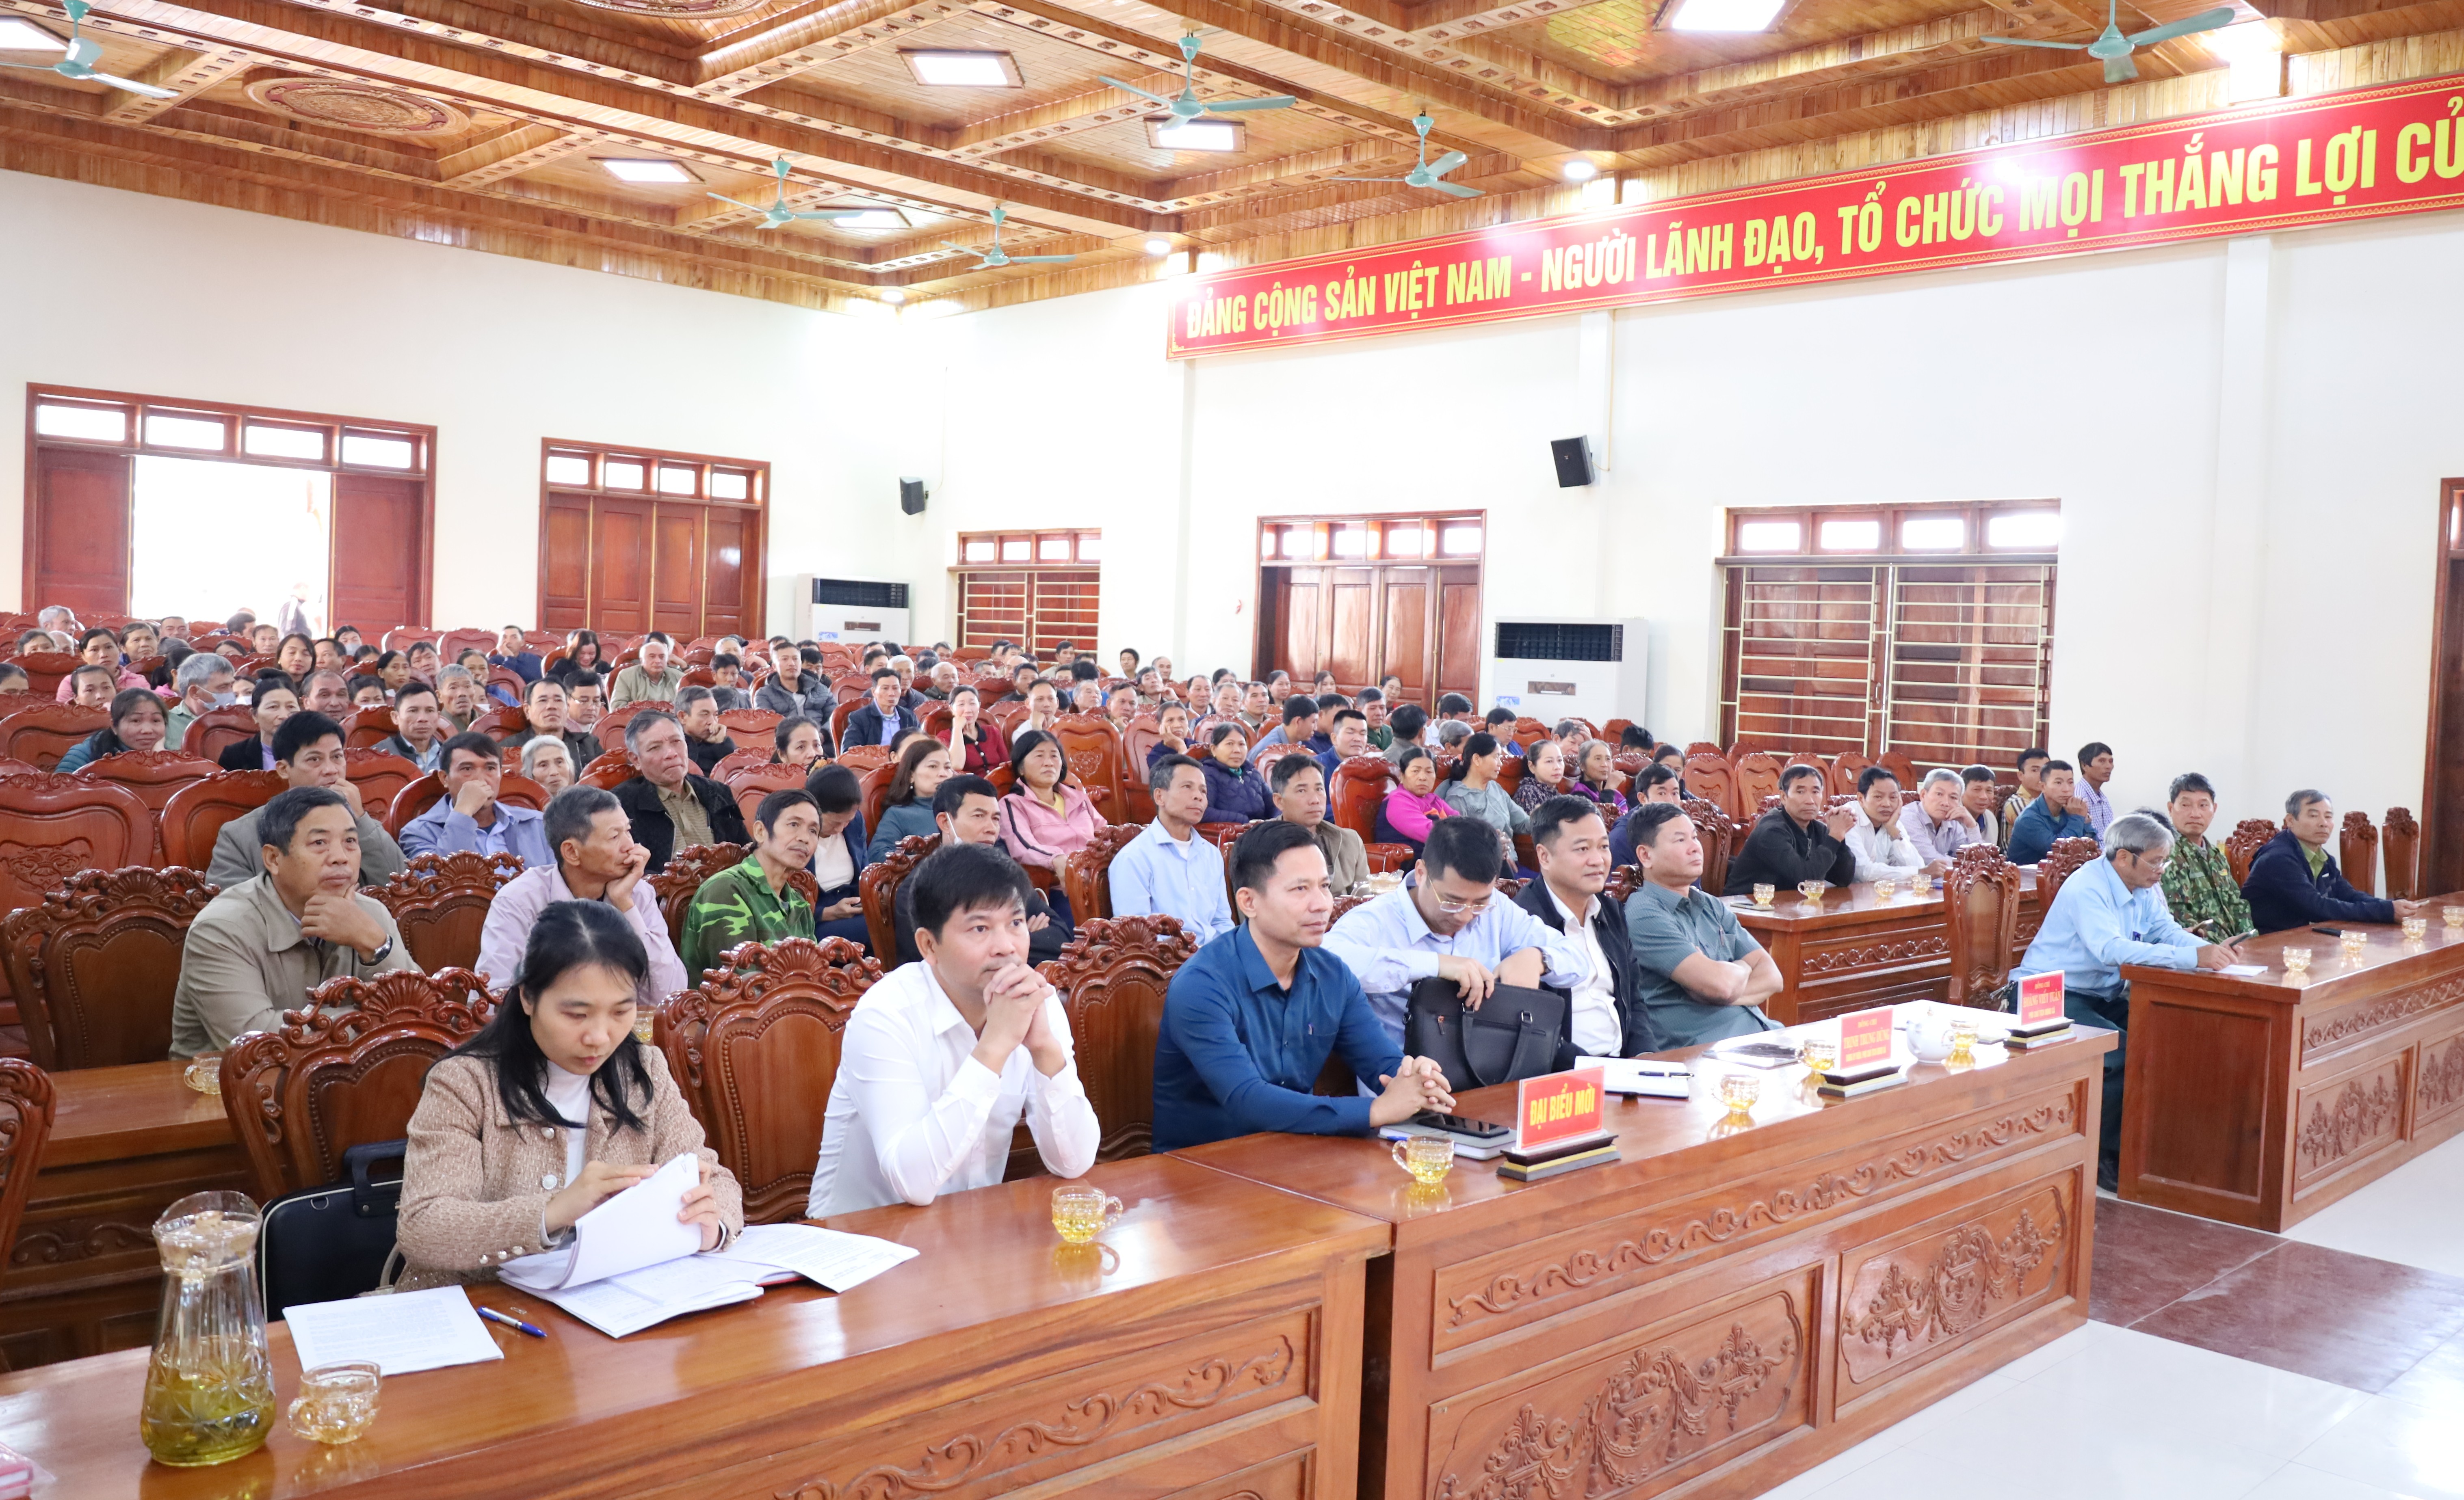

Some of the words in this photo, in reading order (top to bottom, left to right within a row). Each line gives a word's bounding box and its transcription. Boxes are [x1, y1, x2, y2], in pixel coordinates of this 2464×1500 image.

[1187, 287, 1247, 339] ĐẢNG
[1254, 281, 1317, 337] CỘNG
[1324, 265, 1376, 321] SẢN
[1384, 260, 1439, 319] VIỆT
[1446, 255, 1512, 305] NAM
[1541, 228, 1636, 293] NGƯỜI
[1646, 220, 1734, 279] LÃNH
[1743, 211, 1824, 274] ĐẠO,
[1837, 181, 1887, 255] TỔ
[1896, 177, 2005, 248] CHỨC
[2019, 169, 2104, 238] MỌI
[2119, 132, 2279, 218] THẮNG
[2295, 125, 2377, 205] LỢI
[1530, 1098, 1548, 1130] ĐẠI
[1549, 1083, 1573, 1122] BIỂU
[1575, 1083, 1595, 1116] MỜI
